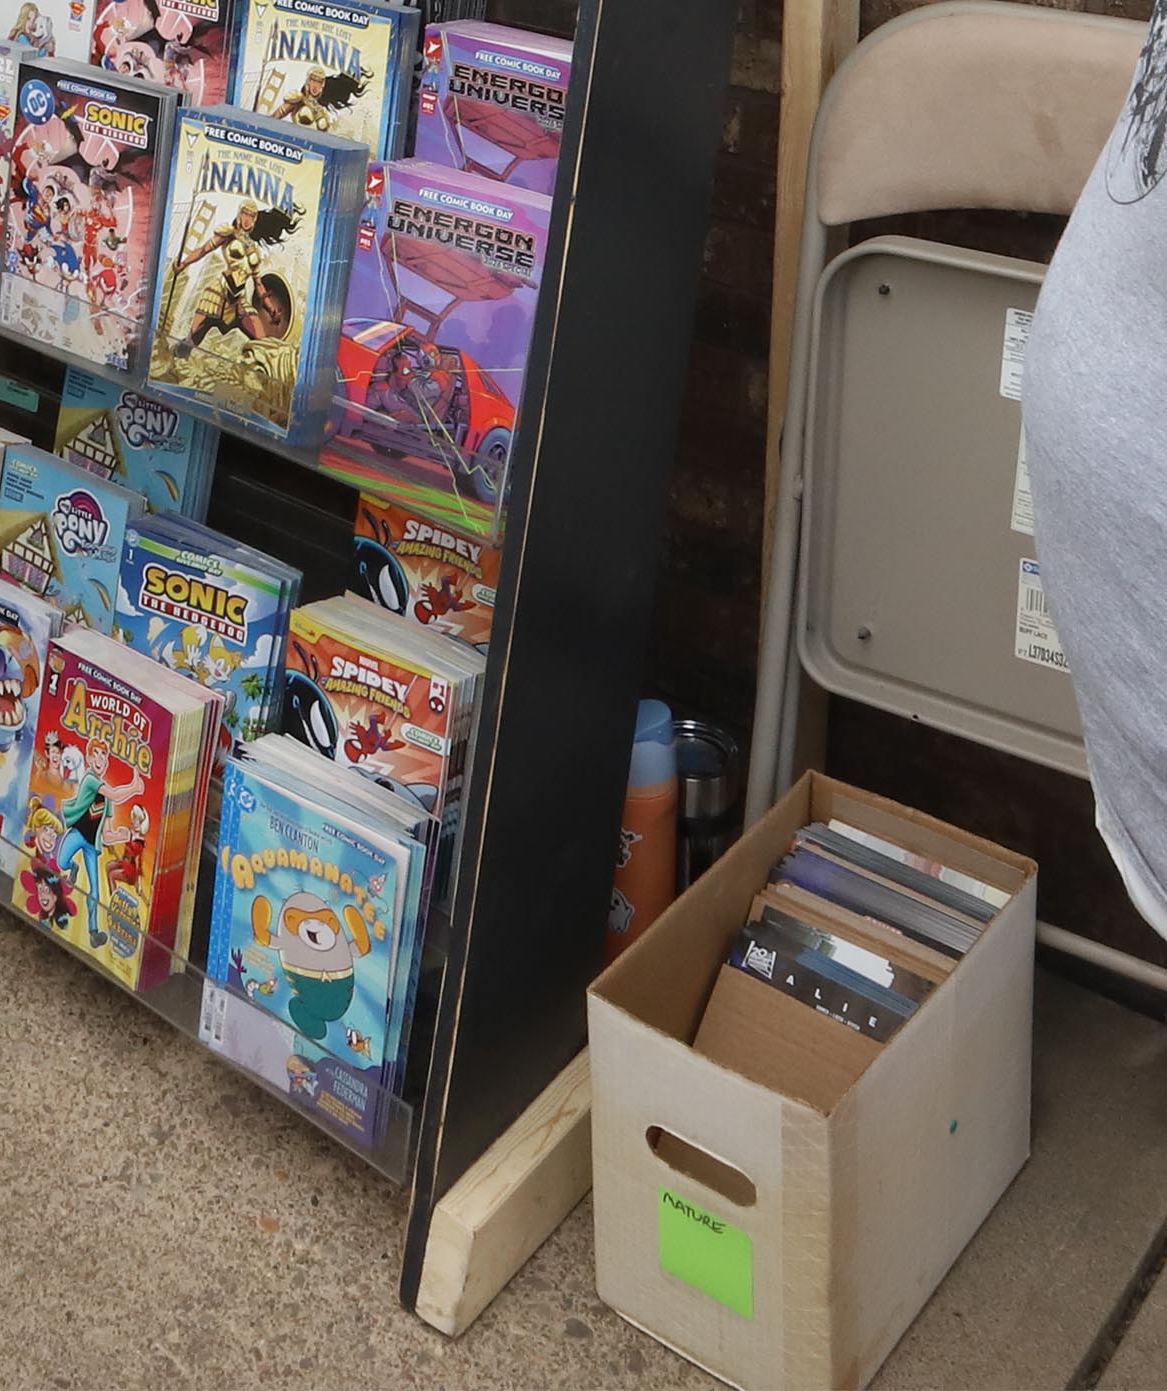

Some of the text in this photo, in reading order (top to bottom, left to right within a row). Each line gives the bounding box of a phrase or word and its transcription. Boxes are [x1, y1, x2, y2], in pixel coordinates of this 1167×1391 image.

[295, 0, 325, 15] COMIC
[325, 8, 351, 21] BOOK
[351, 13, 370, 26] DAY
[475, 51, 562, 80] FREE COMIC BOOK DAY
[87, 103, 147, 135] SONIC
[204, 127, 304, 161] FREE COMIC BOOK DAY
[418, 188, 514, 220] FREE COMIC BOOK DAY
[387, 215, 534, 268] UNIVERSE
[393, 200, 534, 251] ENERGON
[55, 514, 107, 547] PONY
[71, 507, 92, 519] LITTLE
[181, 551, 220, 568] COMICS
[397, 540, 483, 580] AMAZING FRIENDS
[403, 519, 483, 564] SPIDEY
[6, 608, 19, 622] DAY
[145, 566, 248, 627] SONIC
[142, 595, 244, 644] THE HEDGEHOG
[77, 662, 143, 705] FREE COMIC BOOK DAY
[324, 676, 411, 719] AMAZING FRIENDS
[330, 655, 409, 702] SPIDEY
[60, 680, 153, 774] Archie
[90, 693, 147, 731] WORLD OF
[269, 816, 284, 835] BEN
[285, 823, 320, 853] CLANTON
[231, 847, 386, 941] AQUAMANATEE
